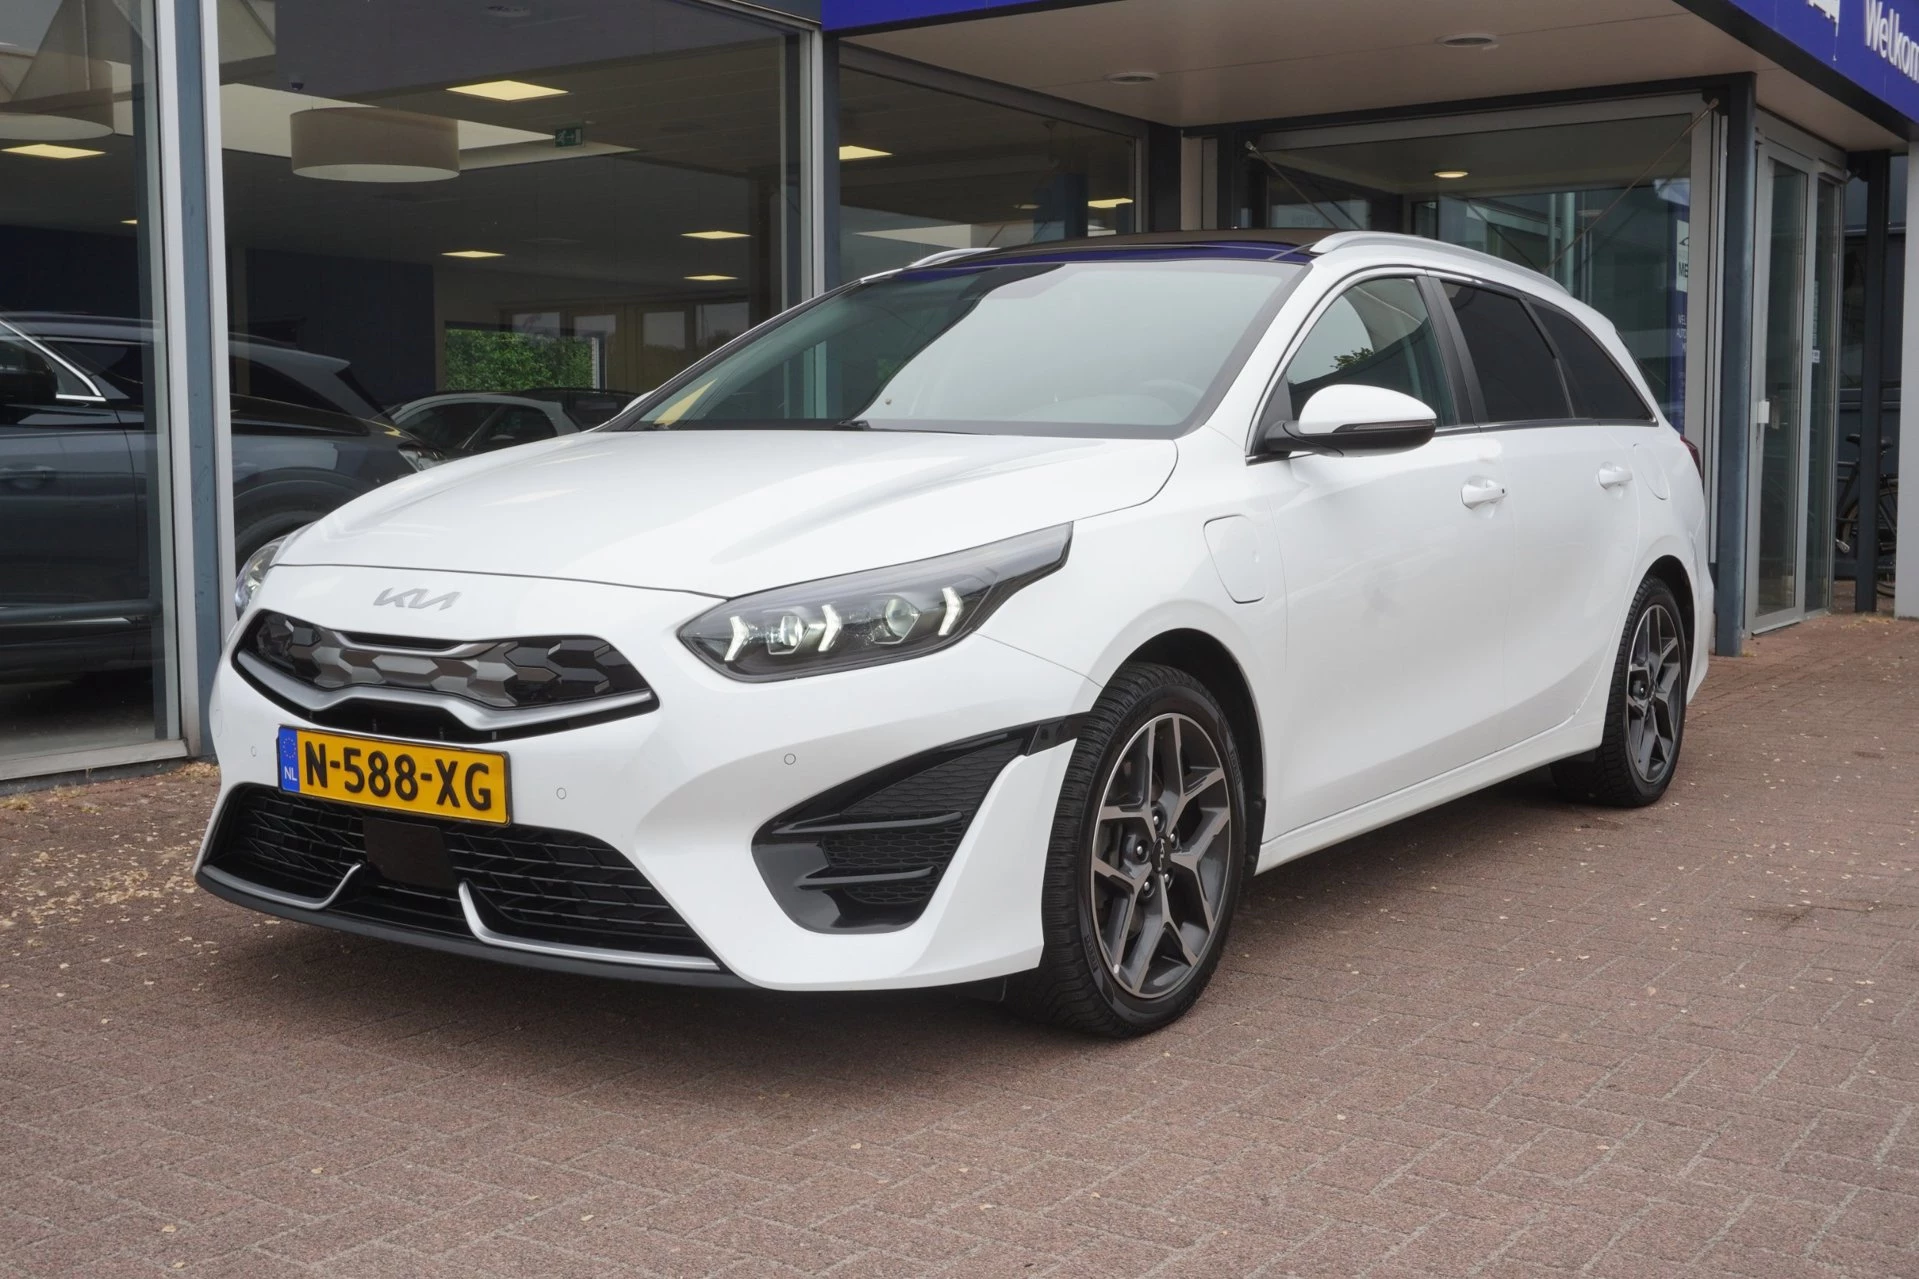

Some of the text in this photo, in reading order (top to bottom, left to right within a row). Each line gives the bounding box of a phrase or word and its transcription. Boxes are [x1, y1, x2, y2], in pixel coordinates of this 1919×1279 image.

[1865, 0, 1919, 83] Welkom
[284, 766, 297, 782] NL
[305, 741, 492, 811] N-588-XG
